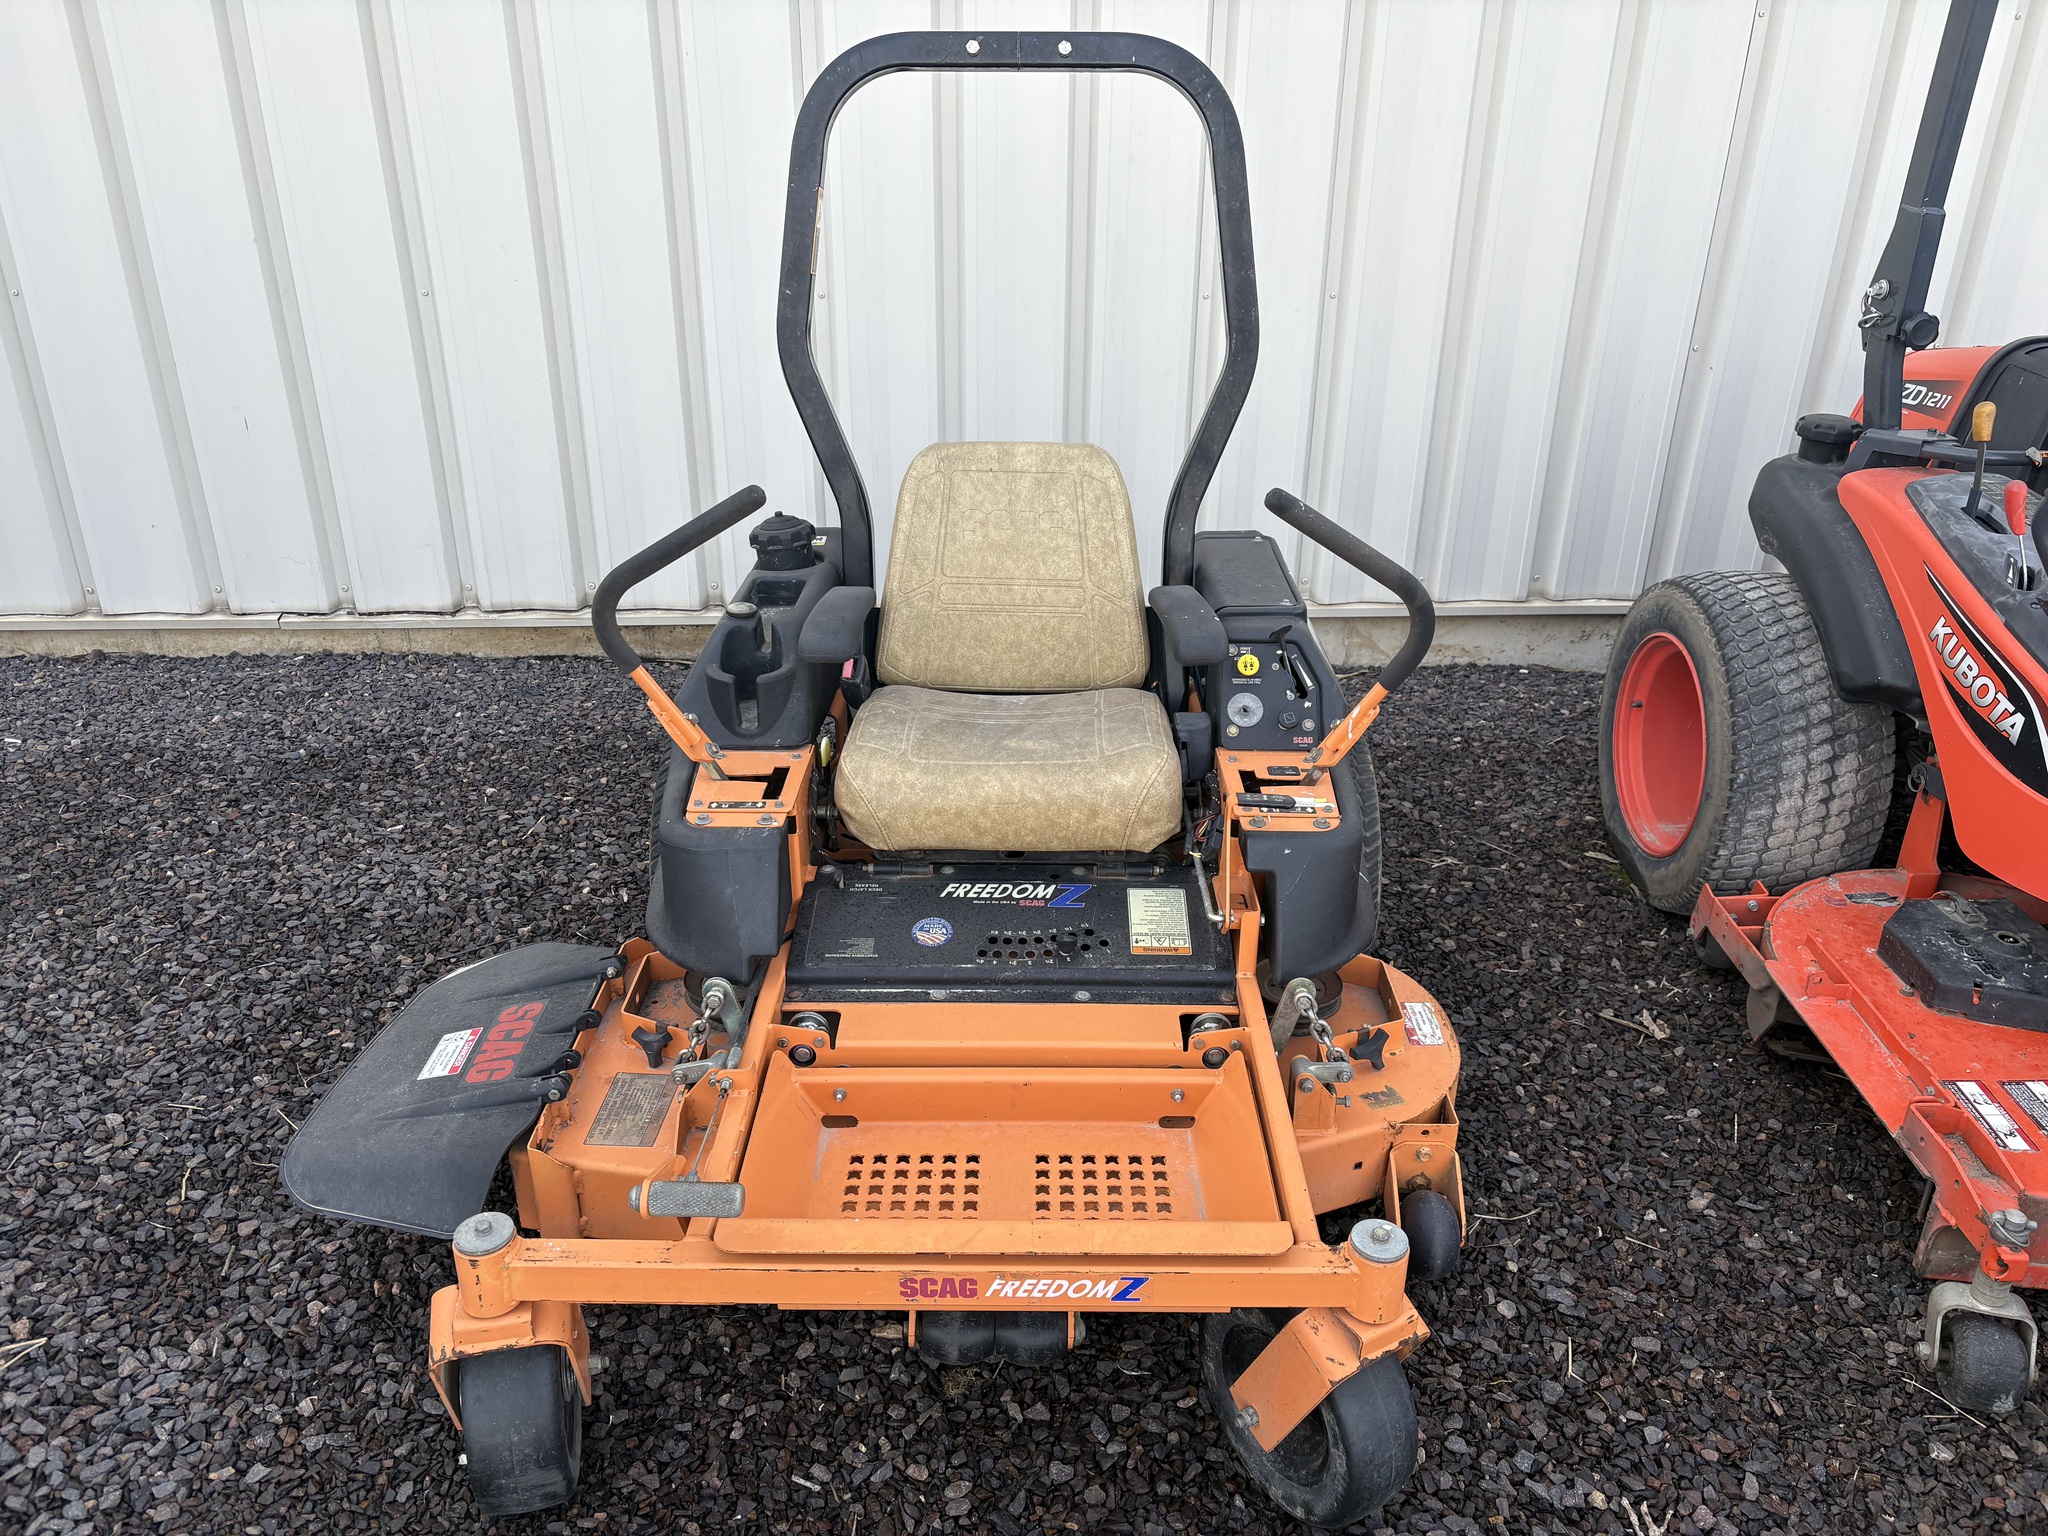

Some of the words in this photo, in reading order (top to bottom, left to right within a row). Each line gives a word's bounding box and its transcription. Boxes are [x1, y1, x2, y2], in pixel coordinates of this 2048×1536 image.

[1928, 614, 2026, 746] KUBOTA
[464, 1002, 544, 1084] SCAG
[1997, 1107, 2019, 1128] DANGER
[900, 1278, 978, 1298] SCAG
